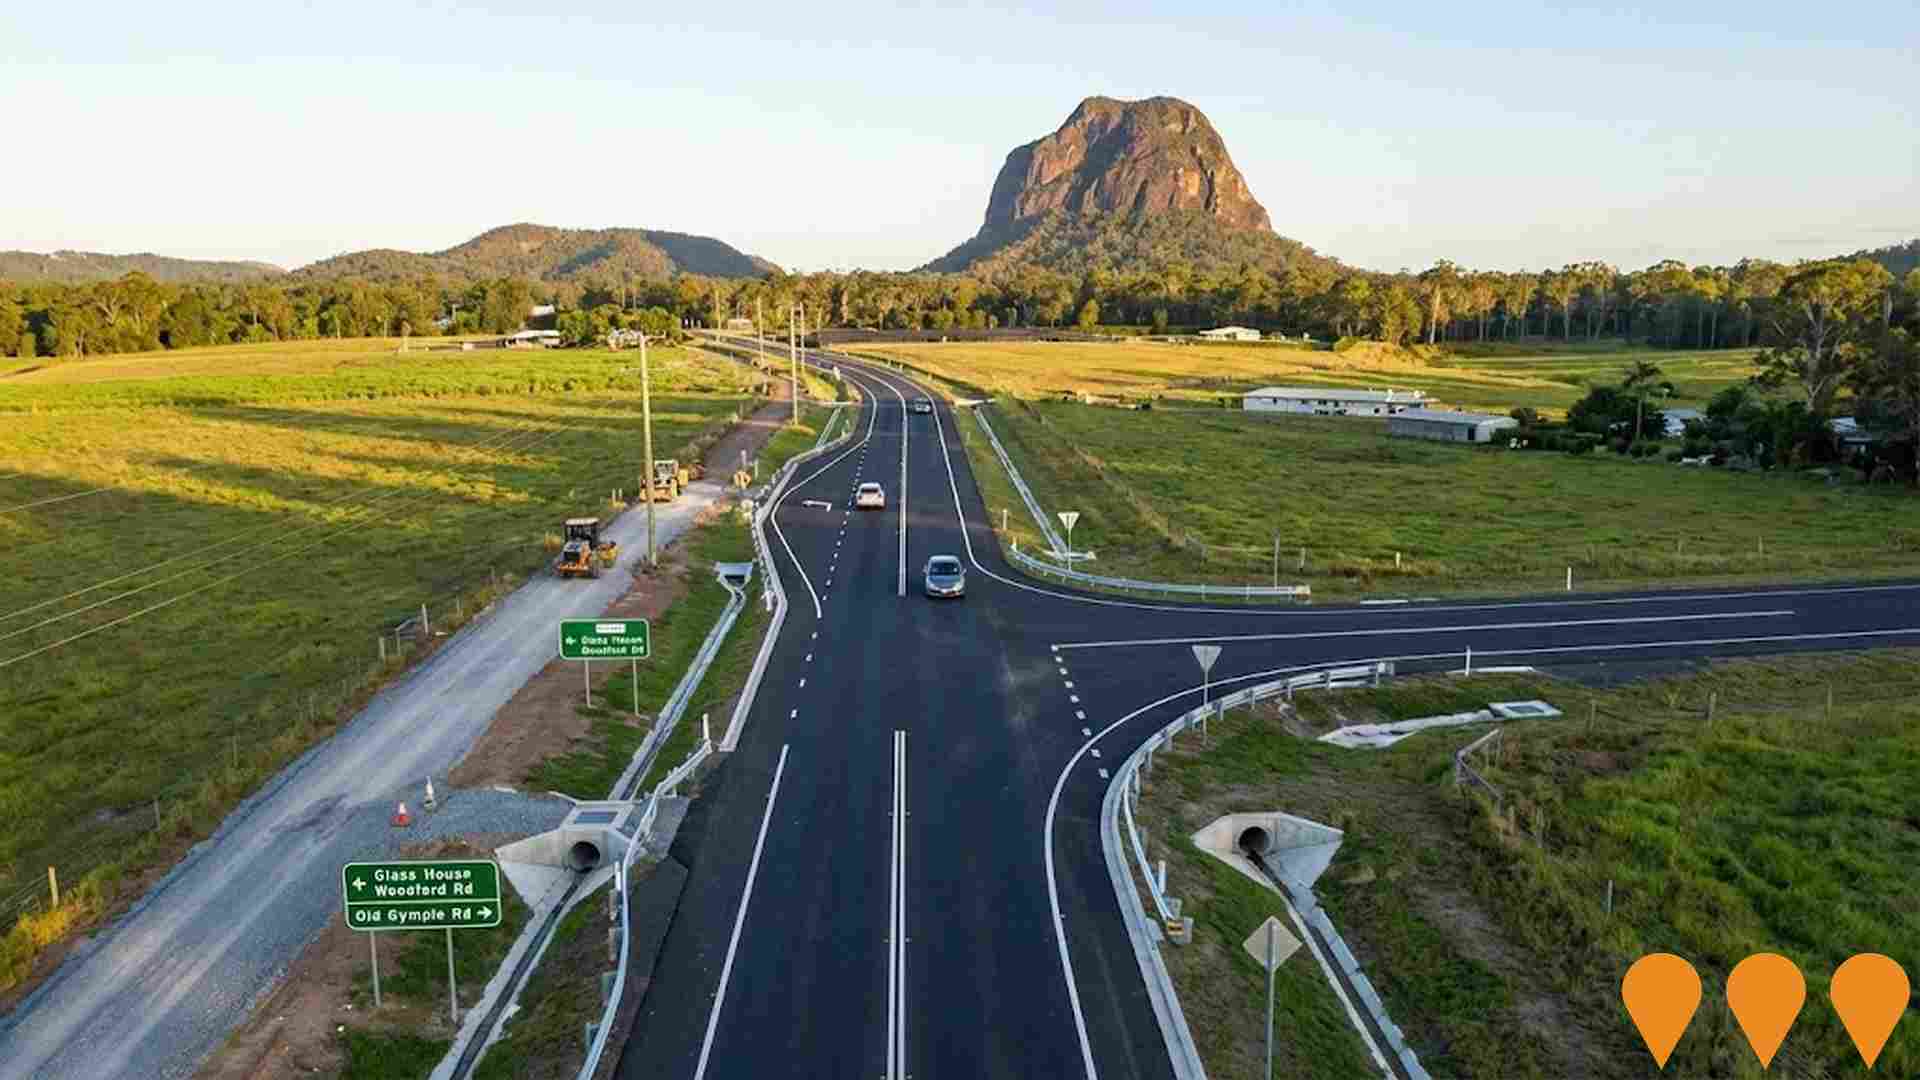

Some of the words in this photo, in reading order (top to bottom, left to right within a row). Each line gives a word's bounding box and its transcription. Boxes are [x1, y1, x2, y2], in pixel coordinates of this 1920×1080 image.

[374, 869, 416, 881] Glass
[424, 868, 471, 880] House
[454, 882, 473, 895] Rd
[355, 909, 381, 922] Old
[452, 907, 472, 920] Rd
